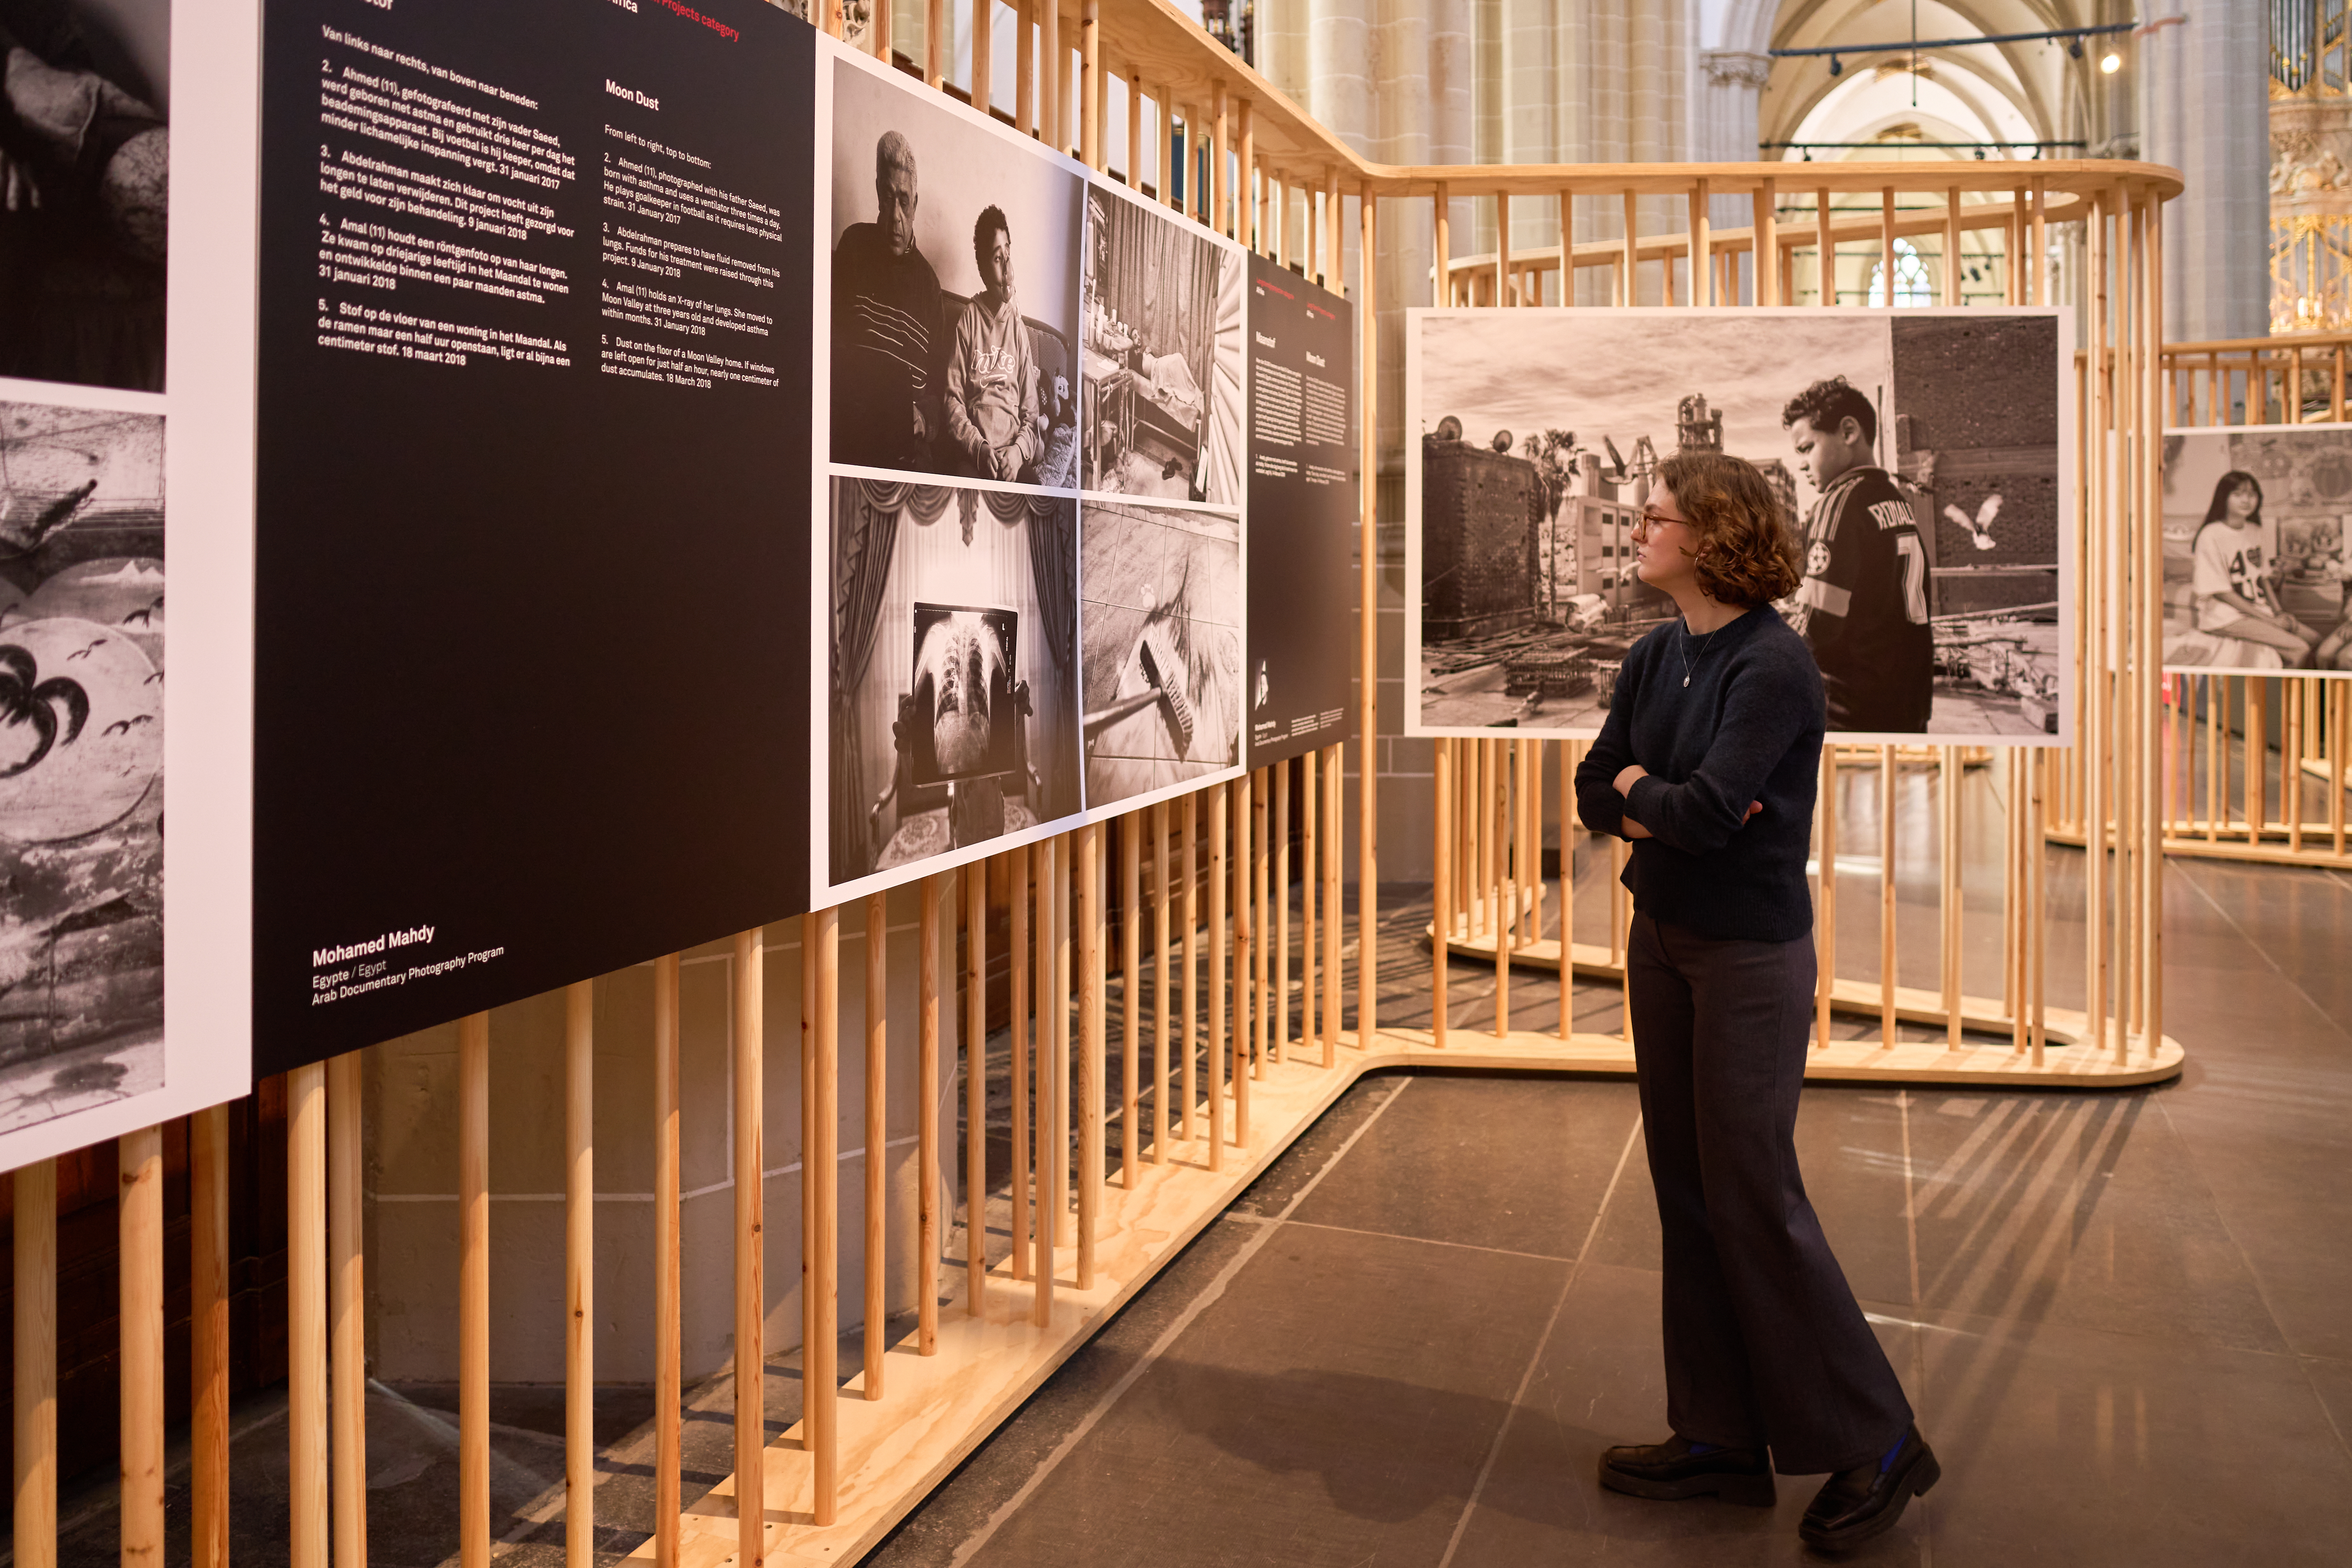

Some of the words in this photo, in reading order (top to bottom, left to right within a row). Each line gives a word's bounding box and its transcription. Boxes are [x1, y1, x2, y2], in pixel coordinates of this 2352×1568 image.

[608, 0, 637, 13] rica
[701, 15, 739, 42] category
[322, 25, 343, 42] Van
[344, 33, 369, 52] links
[371, 45, 394, 60] naar
[396, 54, 430, 74] rechts,
[431, 66, 448, 78] van
[450, 70, 477, 88] boven
[478, 83, 498, 95] naar
[500, 88, 538, 109] beneden:
[322, 59, 332, 73] 2.
[343, 67, 379, 88] Ahmed
[381, 78, 400, 96] (11),
[402, 88, 471, 118] gefotografeerd
[472, 112, 490, 124] met
[491, 117, 507, 130] zijn
[508, 123, 532, 137] vader
[533, 129, 560, 148] Saeed,
[606, 79, 633, 101] Moon
[636, 91, 659, 111] Dust
[321, 113, 358, 131] minder
[360, 122, 419, 149] lichamelijke
[421, 140, 471, 167] inspanning
[472, 158, 498, 173] vergt.
[500, 164, 509, 175] 31
[511, 167, 540, 184] januari
[541, 176, 560, 189] 2017
[322, 93, 430, 136] beademingsapparaat.
[432, 127, 444, 143] Bij
[446, 134, 479, 151] voetbal
[481, 143, 489, 154] is
[491, 145, 501, 161] hij
[503, 149, 533, 169] keeper,
[535, 161, 561, 176] omdat
[562, 168, 575, 180] dat
[605, 125, 623, 139] From
[625, 131, 637, 144] left
[638, 137, 646, 146] to
[647, 140, 665, 154] right,
[666, 146, 677, 158] top
[678, 151, 685, 160] to
[687, 153, 711, 169] bottom:
[320, 161, 355, 181] longen
[357, 172, 368, 184] te
[369, 174, 395, 191] laten
[396, 184, 453, 206] verwijderen.
[455, 197, 468, 210] Dit
[470, 203, 500, 218] project
[501, 209, 524, 225] heeft
[525, 218, 556, 234] gezorgd
[557, 226, 574, 237] voor
[320, 178, 338, 194] het
[340, 186, 363, 200] geld
[364, 192, 387, 205] voor
[388, 197, 406, 212] zijn
[408, 201, 467, 228] behandeling.
[468, 216, 475, 227] 9
[476, 218, 506, 235] januari
[507, 226, 527, 240] 2018
[604, 195, 626, 209] strain.
[628, 202, 635, 212] 31
[637, 205, 664, 222] January
[665, 213, 680, 224] 2017
[604, 180, 614, 192] He
[615, 185, 634, 198] plays
[635, 192, 672, 209] goalkeeper
[673, 201, 679, 211] in
[680, 204, 705, 219] football
[715, 214, 720, 223] it
[721, 218, 745, 231] requires
[746, 223, 758, 234] less
[759, 228, 782, 242] physical
[319, 264, 331, 277] 31
[334, 267, 371, 285] januari
[372, 275, 396, 289] 2018
[322, 230, 336, 244] Ze
[338, 234, 369, 251] kwam
[371, 244, 384, 257] op
[386, 245, 432, 267] driejarige
[434, 255, 467, 274] leeftijd
[468, 262, 477, 274] in
[478, 265, 493, 278] het
[495, 269, 531, 286] Maandal
[532, 278, 541, 288] te
[543, 281, 569, 293] wonen
[603, 236, 624, 251] lungs.
[626, 242, 646, 256] Funds
[648, 248, 658, 258] for
[659, 249, 669, 262] his
[670, 254, 702, 270] treatment
[704, 265, 719, 274] were
[720, 268, 738, 279] raised
[739, 272, 762, 287] through
[762, 276, 774, 288] this
[603, 250, 630, 265] project.
[631, 257, 636, 267] 9
[637, 259, 664, 275] January
[665, 266, 680, 278] 2018
[602, 292, 622, 305] Moon
[623, 297, 644, 312] Valley
[645, 303, 652, 312] at
[653, 304, 671, 315] three
[672, 309, 690, 319] years
[691, 312, 701, 322] old
[702, 316, 714, 325] and
[715, 317, 746, 331] developed
[747, 325, 768, 336] asthma
[602, 307, 623, 319] within
[625, 311, 653, 325] months.
[654, 317, 662, 327] 31
[664, 319, 690, 335] January
[691, 325, 706, 335] 2018
[318, 335, 376, 352] centimeter
[377, 343, 400, 356] stof.
[402, 346, 413, 358] 18
[415, 350, 444, 363] maart
[445, 352, 466, 366] 2018
[602, 335, 608, 344] 5.
[616, 337, 633, 349] Dust
[644, 343, 656, 353] the
[657, 344, 672, 356] floor
[673, 348, 680, 357] of
[687, 350, 704, 361] Moon
[706, 353, 724, 367] Valley
[725, 357, 743, 368] home.
[745, 361, 749, 369] If
[750, 362, 774, 374] windows
[1896, 532, 1928, 625] 7
[313, 934, 385, 968] Mohamed
[389, 925, 435, 948] Mahdy
[312, 989, 337, 1006] Arab
[340, 973, 407, 998] Documentary
[409, 956, 466, 979] Photography
[468, 947, 504, 963] Program
[313, 971, 350, 989] Egypte
[359, 960, 387, 977] Egypt
